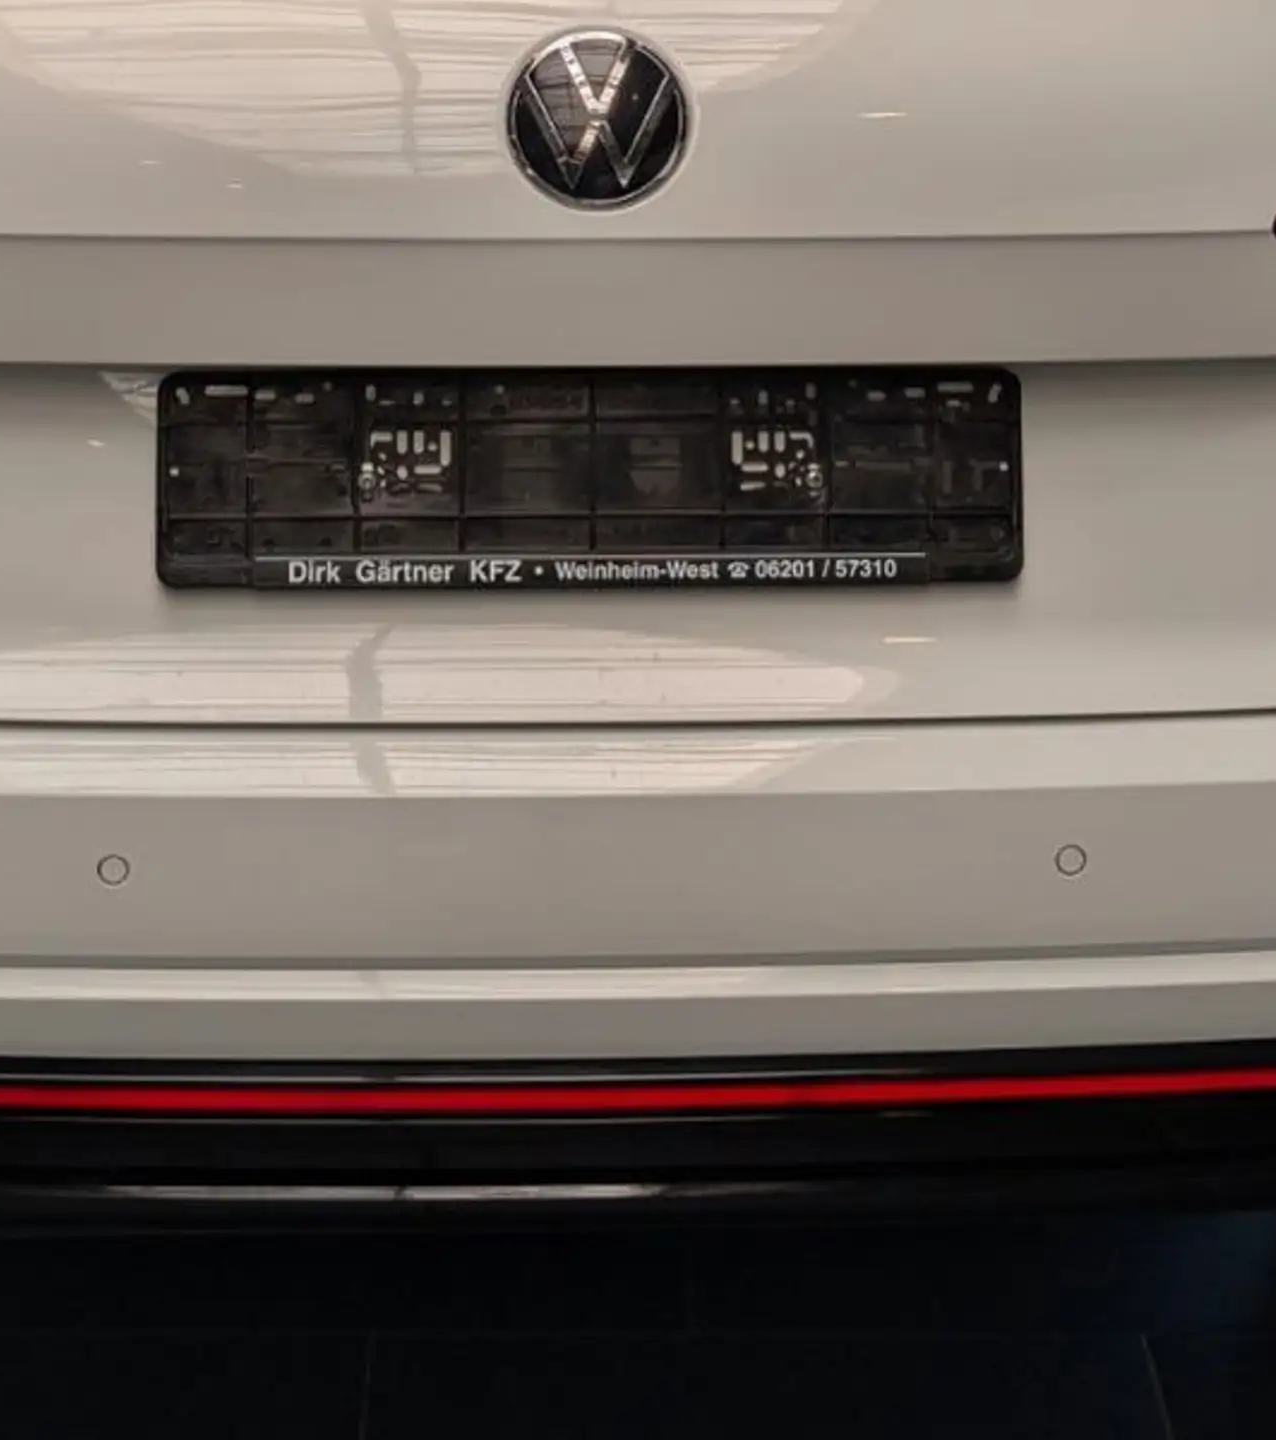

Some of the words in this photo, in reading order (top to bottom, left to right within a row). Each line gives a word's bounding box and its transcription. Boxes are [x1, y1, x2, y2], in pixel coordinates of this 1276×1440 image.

[287, 560, 341, 584] Dirk
[355, 559, 455, 583] Gärtner
[469, 559, 523, 582] KFZ
[554, 560, 719, 581] Weinheim-West
[754, 558, 815, 578] 06201
[835, 558, 897, 578] 57310
